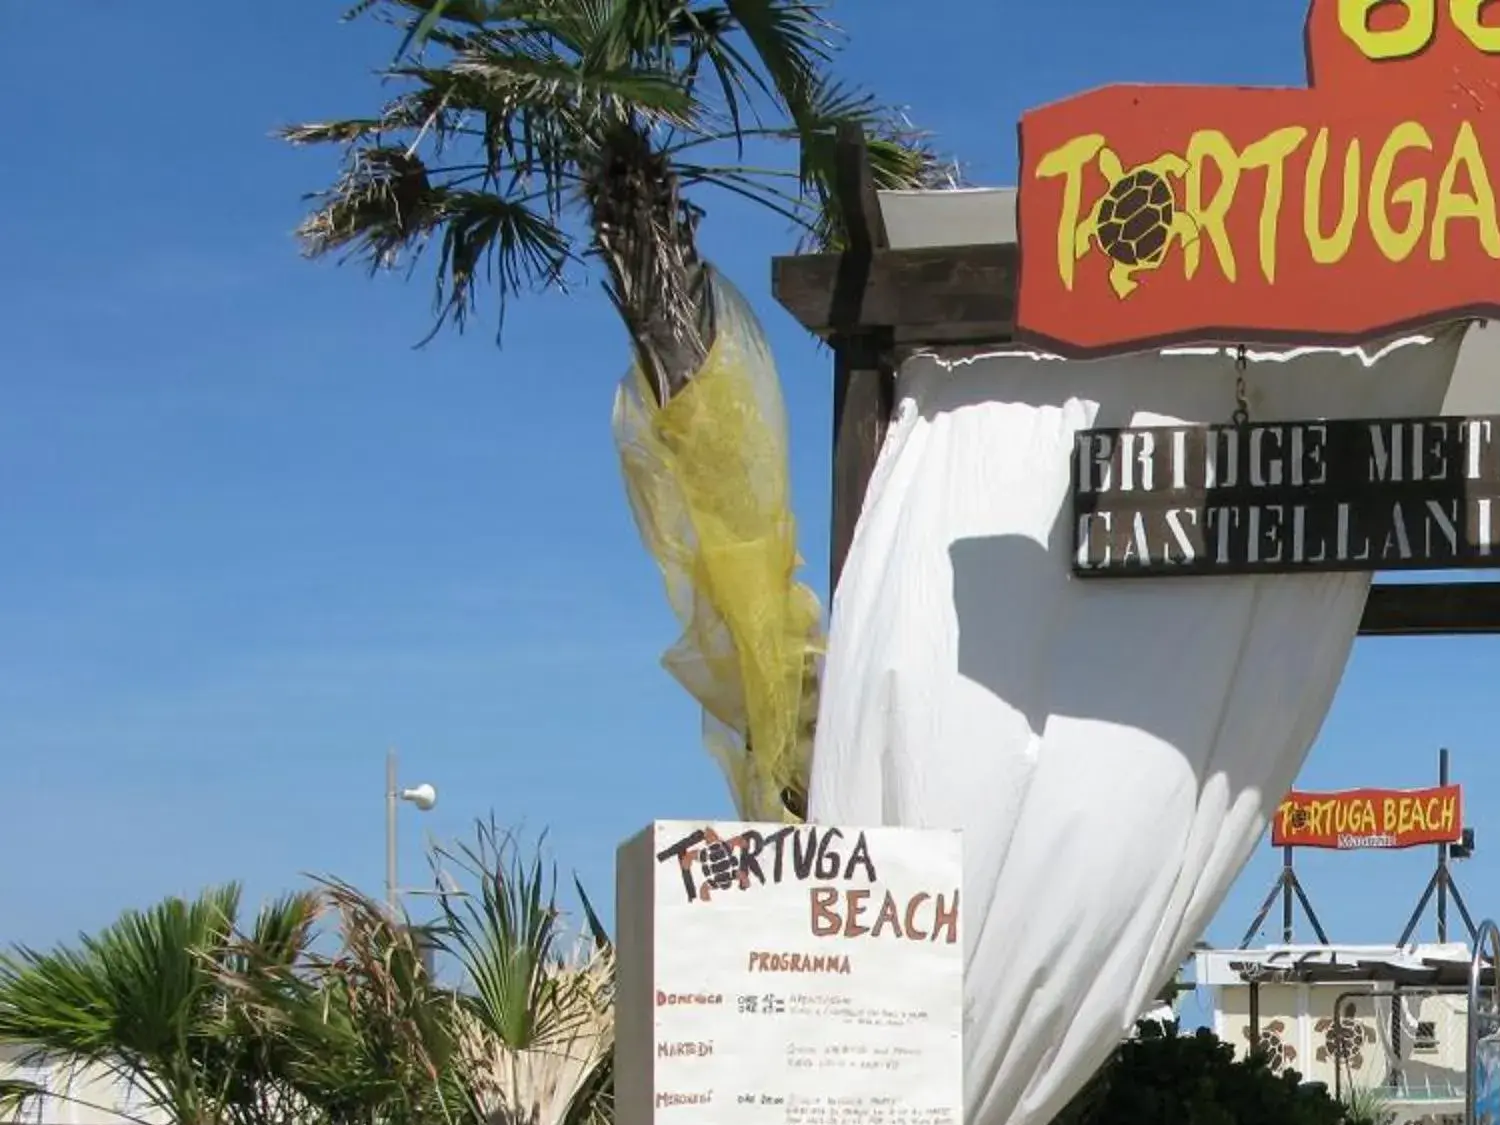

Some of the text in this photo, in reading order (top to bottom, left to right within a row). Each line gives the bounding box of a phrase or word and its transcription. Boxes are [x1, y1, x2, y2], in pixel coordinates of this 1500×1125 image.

[1075, 425, 1328, 493] BRIDGE
[1076, 499, 1492, 570] CASTELLANI
[1383, 795, 1456, 834] BEACH
[810, 886, 960, 944] BEACH
[748, 951, 851, 974] PROGRAMMA
